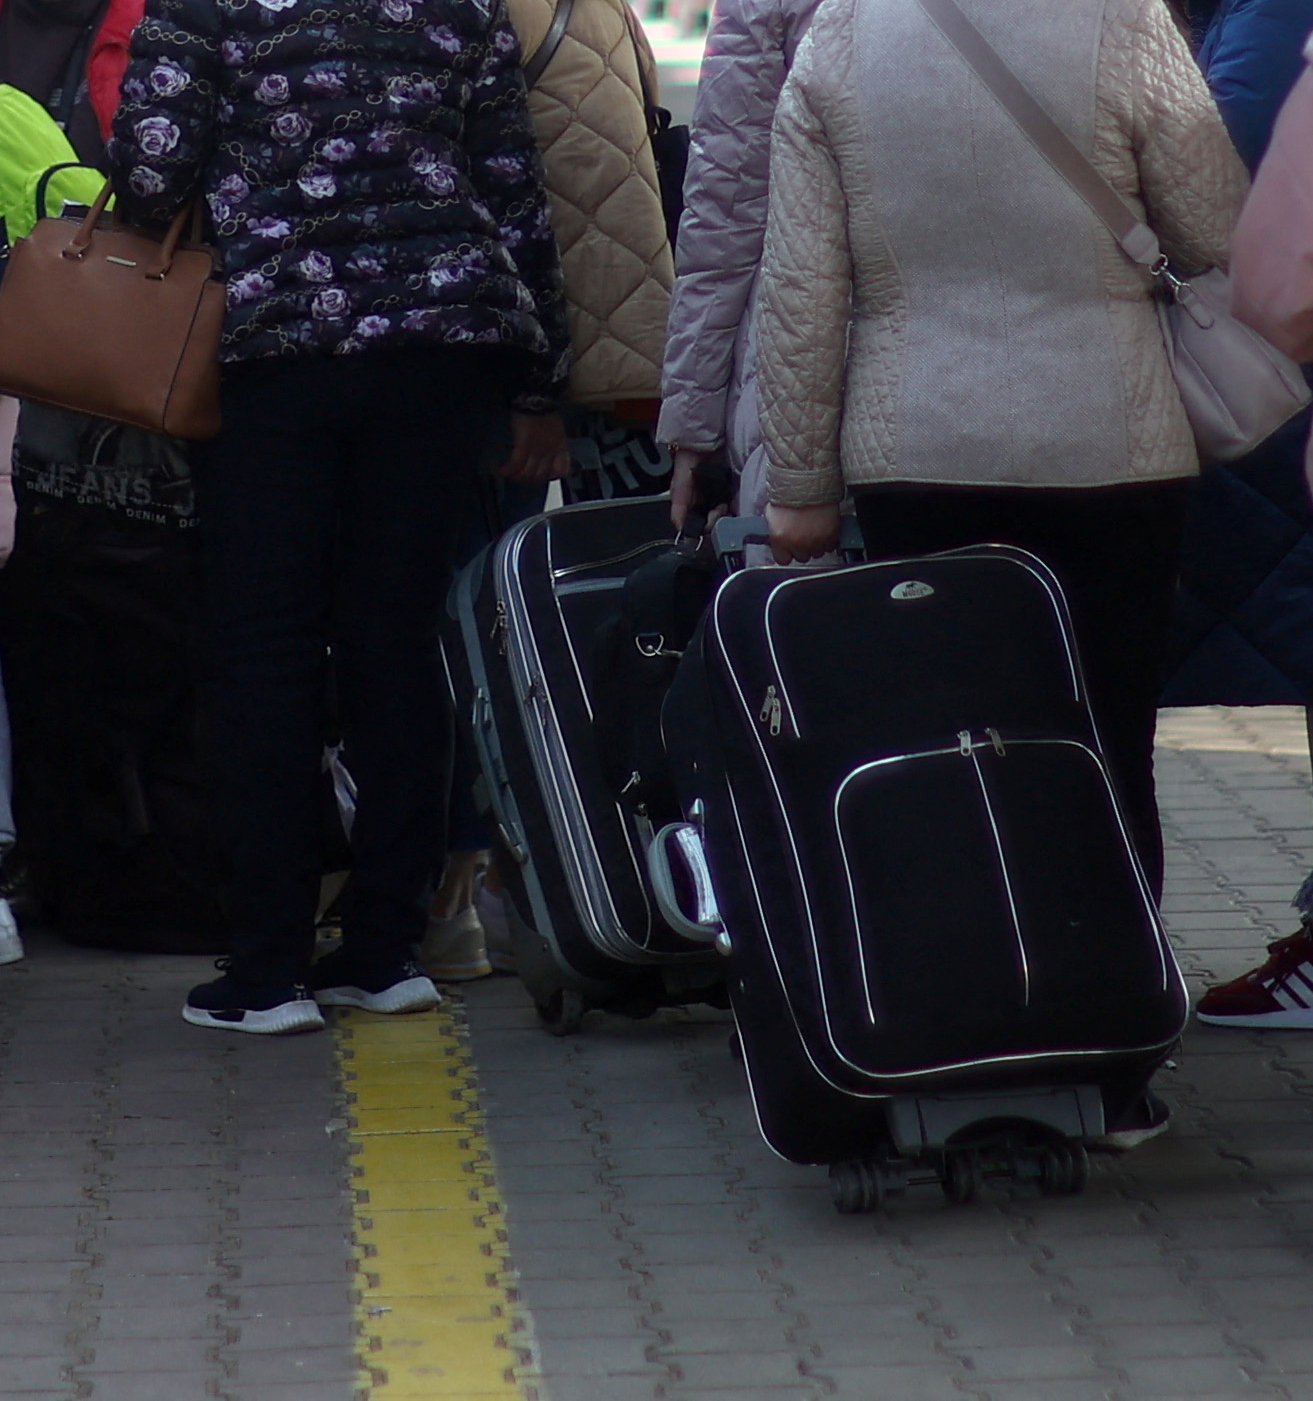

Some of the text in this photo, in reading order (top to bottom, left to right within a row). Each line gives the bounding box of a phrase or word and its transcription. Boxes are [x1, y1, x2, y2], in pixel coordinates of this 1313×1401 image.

[25, 479, 65, 500] DENIM
[125, 506, 168, 525] DENIM
[36, 463, 152, 506] JEANS
